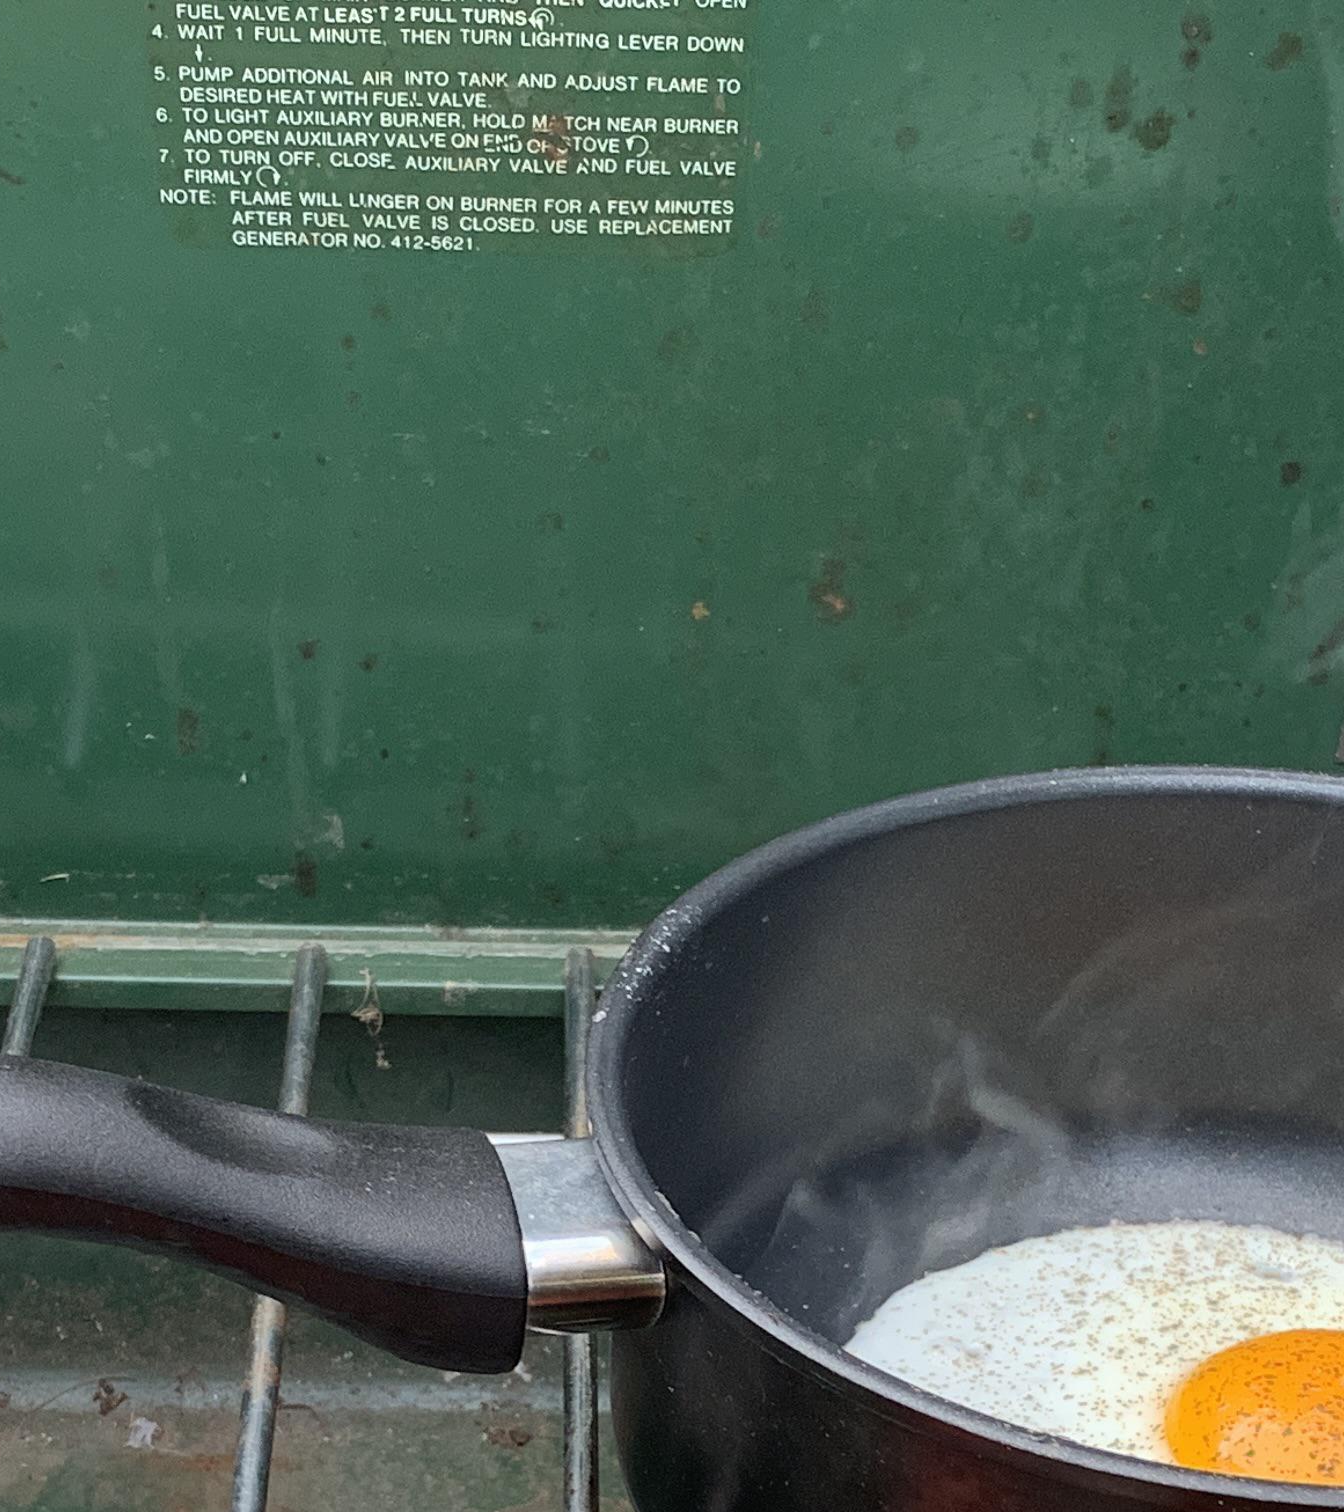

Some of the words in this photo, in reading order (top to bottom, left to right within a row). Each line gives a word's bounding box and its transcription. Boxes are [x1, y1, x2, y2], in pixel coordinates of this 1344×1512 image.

[176, 4, 224, 20] FUEL
[229, 5, 290, 21] VALVE
[295, 7, 319, 21] AT
[324, 6, 389, 23] LEAST
[395, 7, 405, 21] 2
[410, 7, 457, 22] FULL
[462, 8, 527, 25] TURNS
[152, 25, 168, 38] 4.
[178, 24, 224, 39] WAIT
[236, 27, 242, 40] 1
[255, 26, 301, 42] FULL
[400, 29, 450, 44] THEN
[460, 29, 511, 45] TURN
[521, 31, 609, 49] LIGHTING
[619, 35, 678, 50] LEVER
[688, 36, 744, 52] DOWN
[154, 66, 169, 80] 5.
[179, 66, 233, 81] PUMP
[242, 68, 353, 85] ADDITIONAL
[363, 71, 392, 85] AIR
[405, 71, 449, 86] INTO
[458, 72, 509, 87] TANK
[518, 73, 556, 88] AND
[565, 75, 638, 91] ADJUST
[647, 77, 708, 93] FLAME
[717, 79, 740, 94] TO
[180, 87, 262, 103] DESIRED
[267, 89, 315, 104] HEAT
[321, 91, 367, 106] WITH
[373, 92, 423, 107] FUEL
[427, 92, 491, 108] VALVE.
[156, 108, 172, 122] 6.
[182, 108, 208, 123] TO
[215, 109, 269, 124] LIGHT
[277, 110, 373, 126] AUXILIARY
[474, 113, 525, 128] HOLD
[607, 117, 657, 132] NEAR
[664, 118, 738, 134] BURNER
[184, 129, 222, 143] AND
[227, 129, 279, 145] OPEN
[284, 131, 380, 146] AUXILIARY
[384, 133, 446, 148] VALVE
[451, 133, 478, 148] ON
[483, 134, 522, 153] END
[160, 149, 174, 162] 7.
[184, 149, 210, 164] TO
[219, 150, 270, 165] TURN
[330, 152, 395, 169] CLOSE
[405, 156, 500, 171] AUXILIARY
[509, 159, 567, 174] VALVE
[577, 158, 617, 174] AND
[626, 159, 670, 175] FUEL
[680, 161, 736, 176] VALVE
[184, 169, 252, 185] FIRMLY
[160, 189, 216, 204] NOTE:
[230, 190, 292, 206] FLAME
[299, 192, 342, 206] WILL
[349, 193, 419, 209] LINGER
[426, 196, 453, 210] ON
[461, 197, 536, 212] BURNER
[544, 199, 582, 213] FOR
[589, 200, 600, 214] A
[608, 200, 648, 215] FEW
[655, 200, 733, 214] MINUTES
[232, 211, 291, 226] AFTER
[303, 212, 349, 227] FUEL
[362, 214, 420, 229] VALVE
[432, 216, 449, 230] IS
[460, 216, 538, 232] CLOSED.
[551, 219, 587, 234] USE
[599, 220, 732, 235] REPLACEMENT
[232, 230, 347, 247] GENERATOR
[354, 233, 385, 248] NO.
